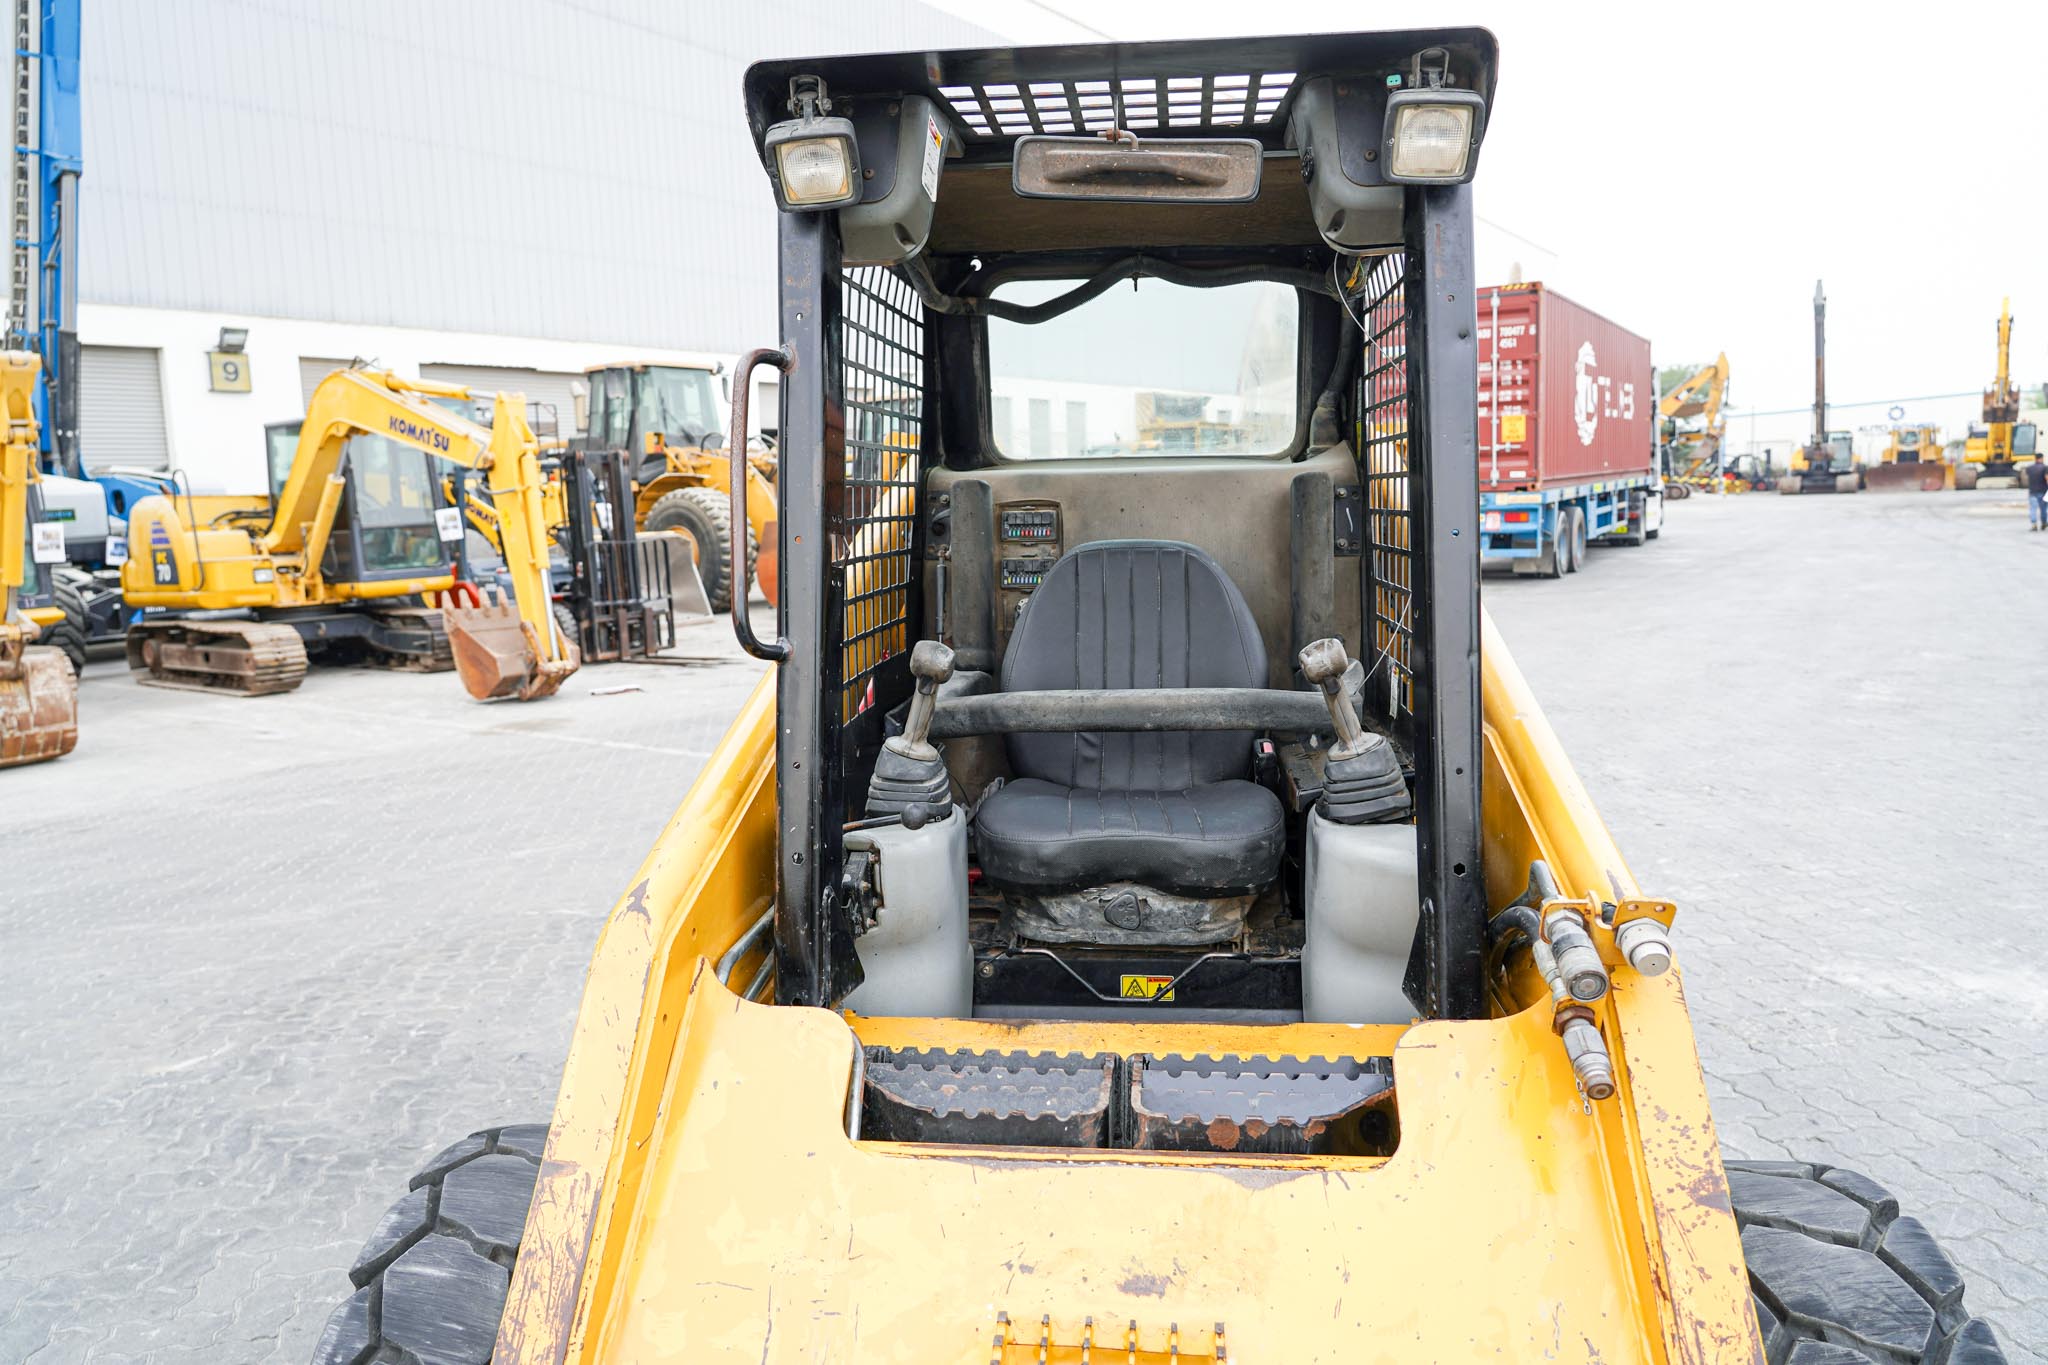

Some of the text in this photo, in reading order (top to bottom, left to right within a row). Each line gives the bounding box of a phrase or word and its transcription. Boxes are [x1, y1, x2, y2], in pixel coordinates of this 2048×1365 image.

[223, 360, 239, 382] 9
[389, 415, 449, 452] KOMATSU
[156, 564, 171, 582] 70
